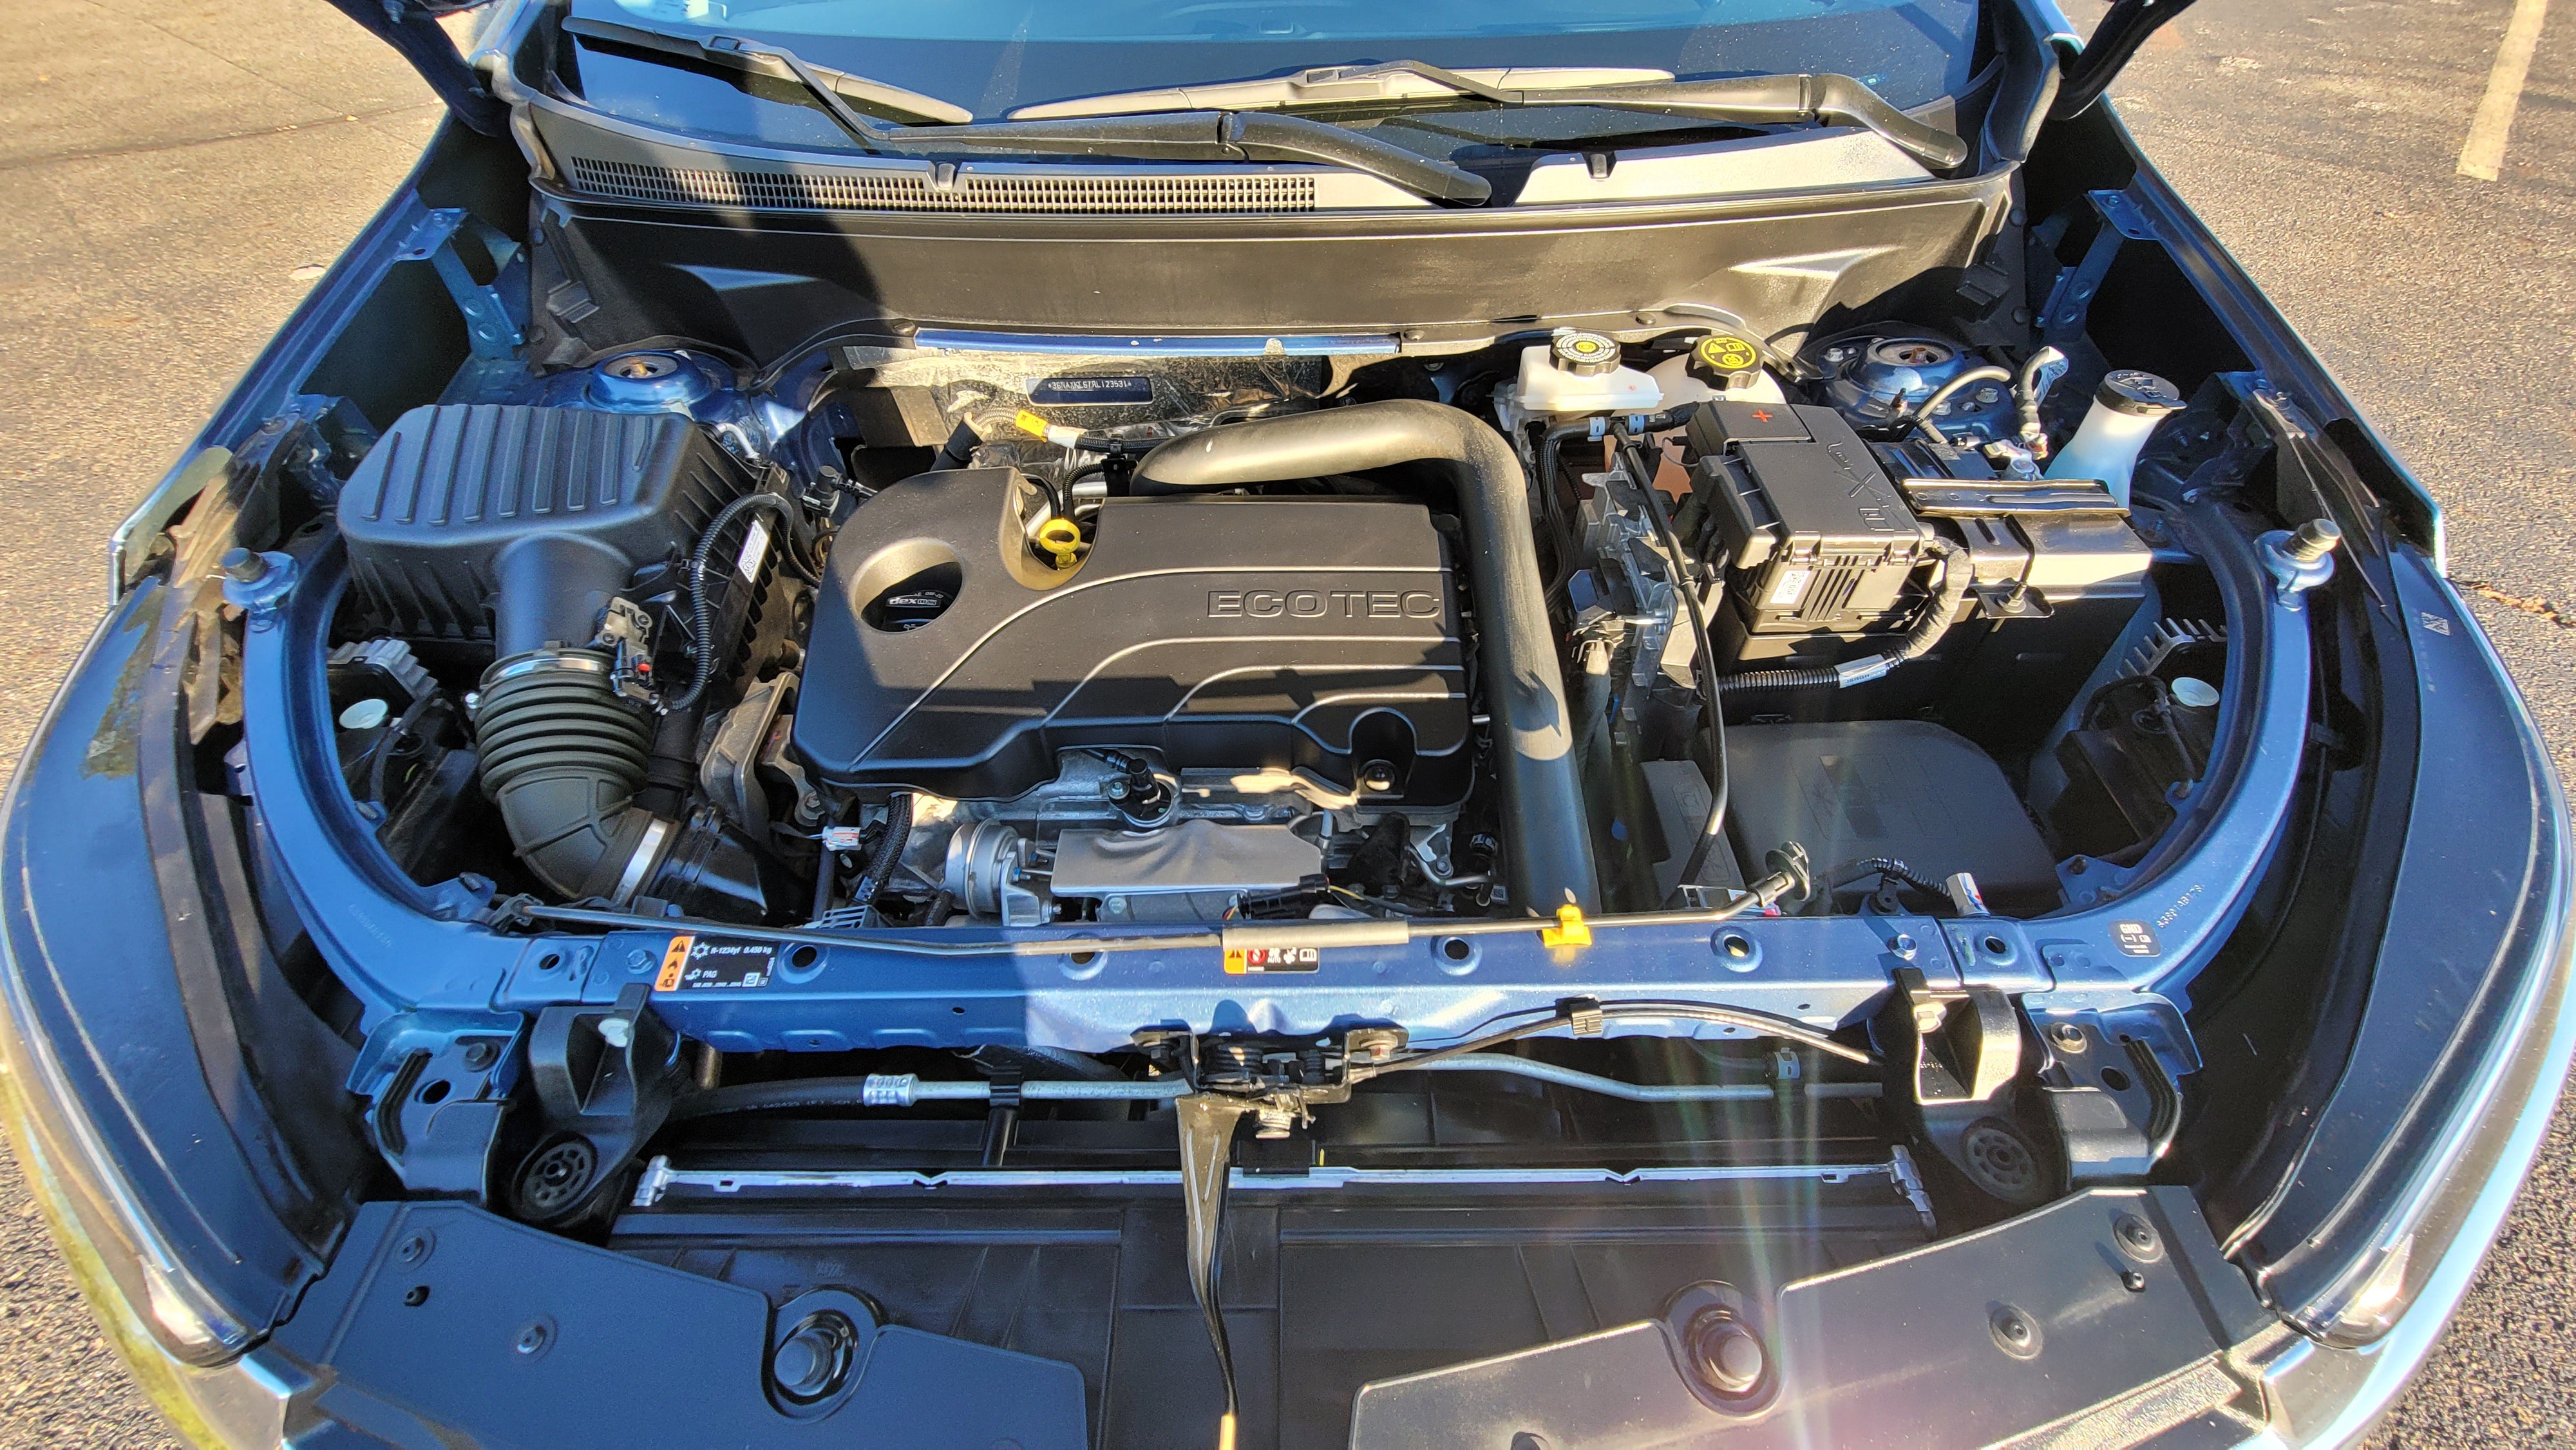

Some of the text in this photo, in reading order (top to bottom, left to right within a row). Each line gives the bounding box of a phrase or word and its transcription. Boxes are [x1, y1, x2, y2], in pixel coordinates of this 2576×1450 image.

[889, 596, 938, 605] dexos
[1208, 589, 1440, 618] ECOTEC
[2119, 924, 2143, 934] GND
[703, 970, 717, 978] PAG
